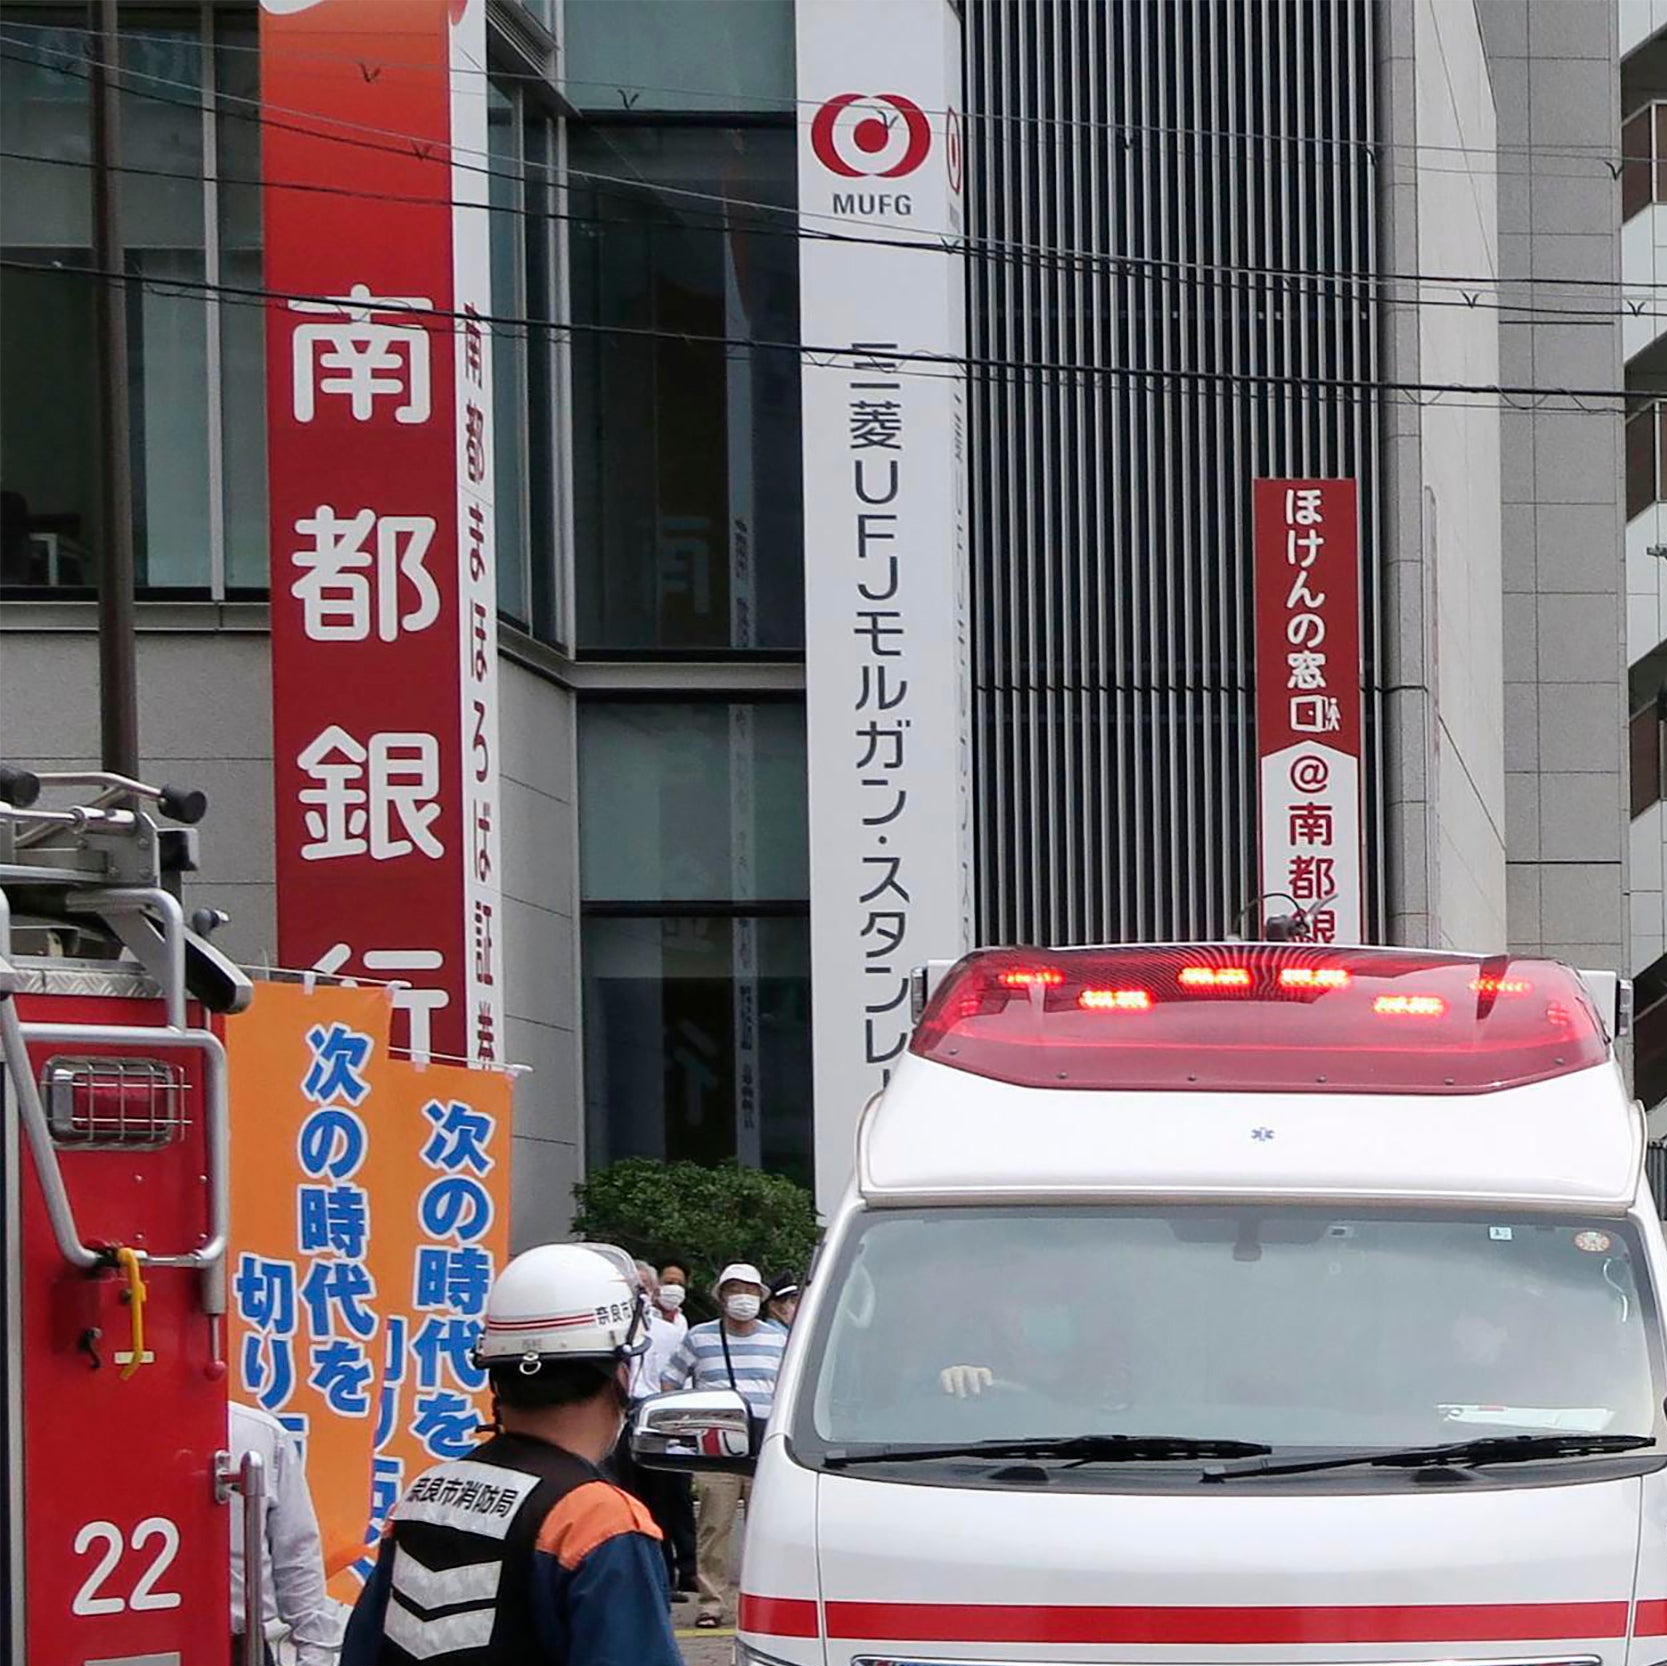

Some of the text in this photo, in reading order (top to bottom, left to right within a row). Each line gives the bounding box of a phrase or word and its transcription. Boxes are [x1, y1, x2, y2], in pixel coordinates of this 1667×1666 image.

[831, 192, 914, 217] MUFG
[288, 283, 450, 1066] 南都銀行
[299, 1024, 379, 1415] 次の時代を
[406, 1478, 519, 1520] 奈良市消防局
[73, 1517, 182, 1618] 22
